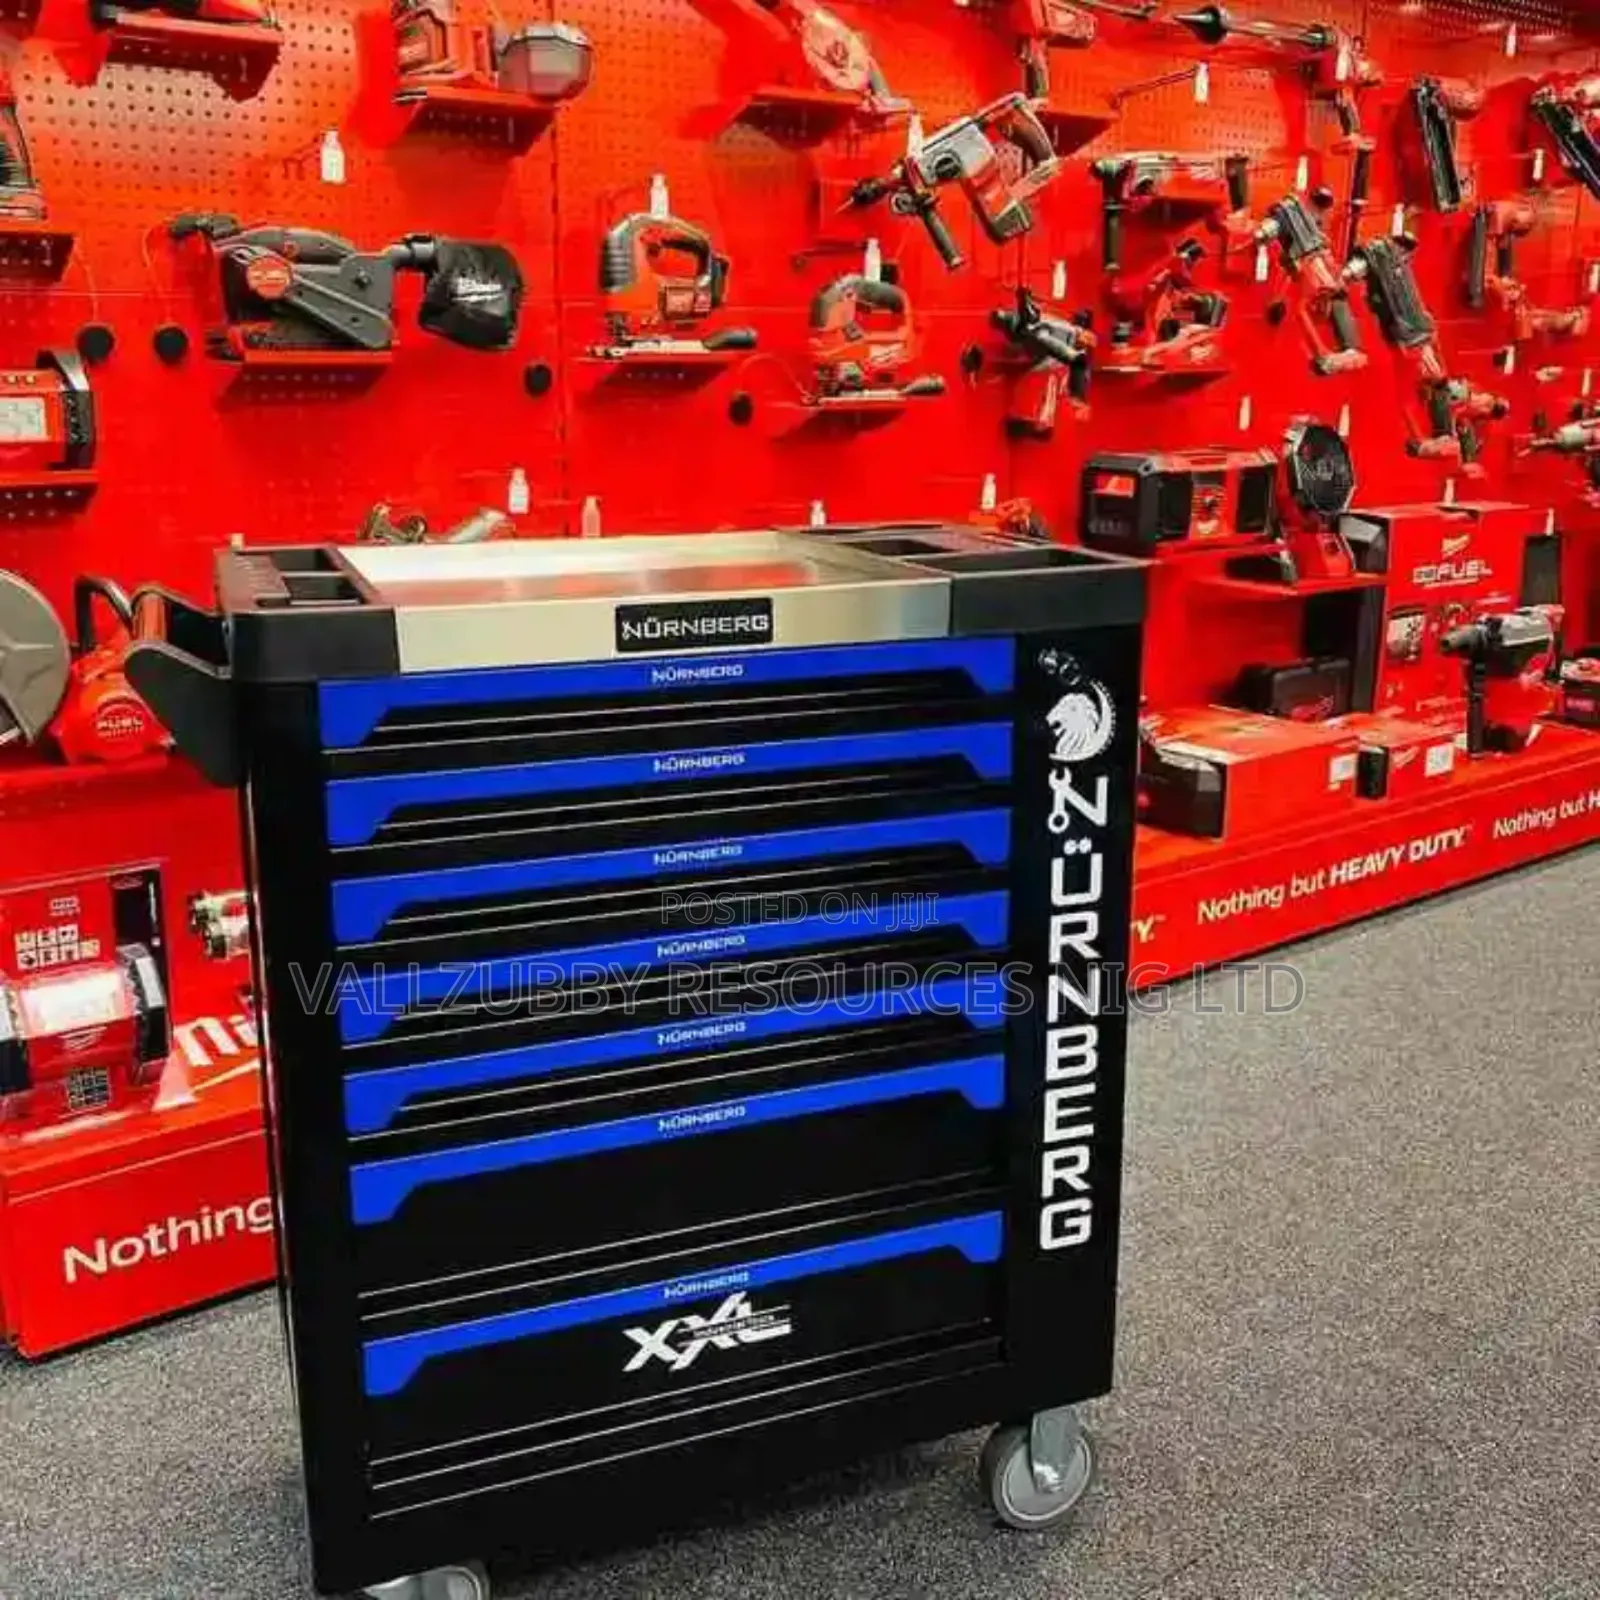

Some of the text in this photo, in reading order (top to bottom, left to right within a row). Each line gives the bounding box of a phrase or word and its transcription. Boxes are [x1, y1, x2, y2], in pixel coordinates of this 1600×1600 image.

[621, 614, 769, 640] NÜRNBERG
[652, 664, 743, 683] NÜRNBERG
[653, 753, 745, 773] NÜRNBERG
[1492, 802, 1556, 839] Nothing
[1559, 793, 1586, 819] but
[1197, 884, 1284, 925] Nothing
[1290, 869, 1325, 898] but
[1328, 843, 1403, 886] HEAVY
[1040, 767, 1109, 1250] NÜRNBERG
